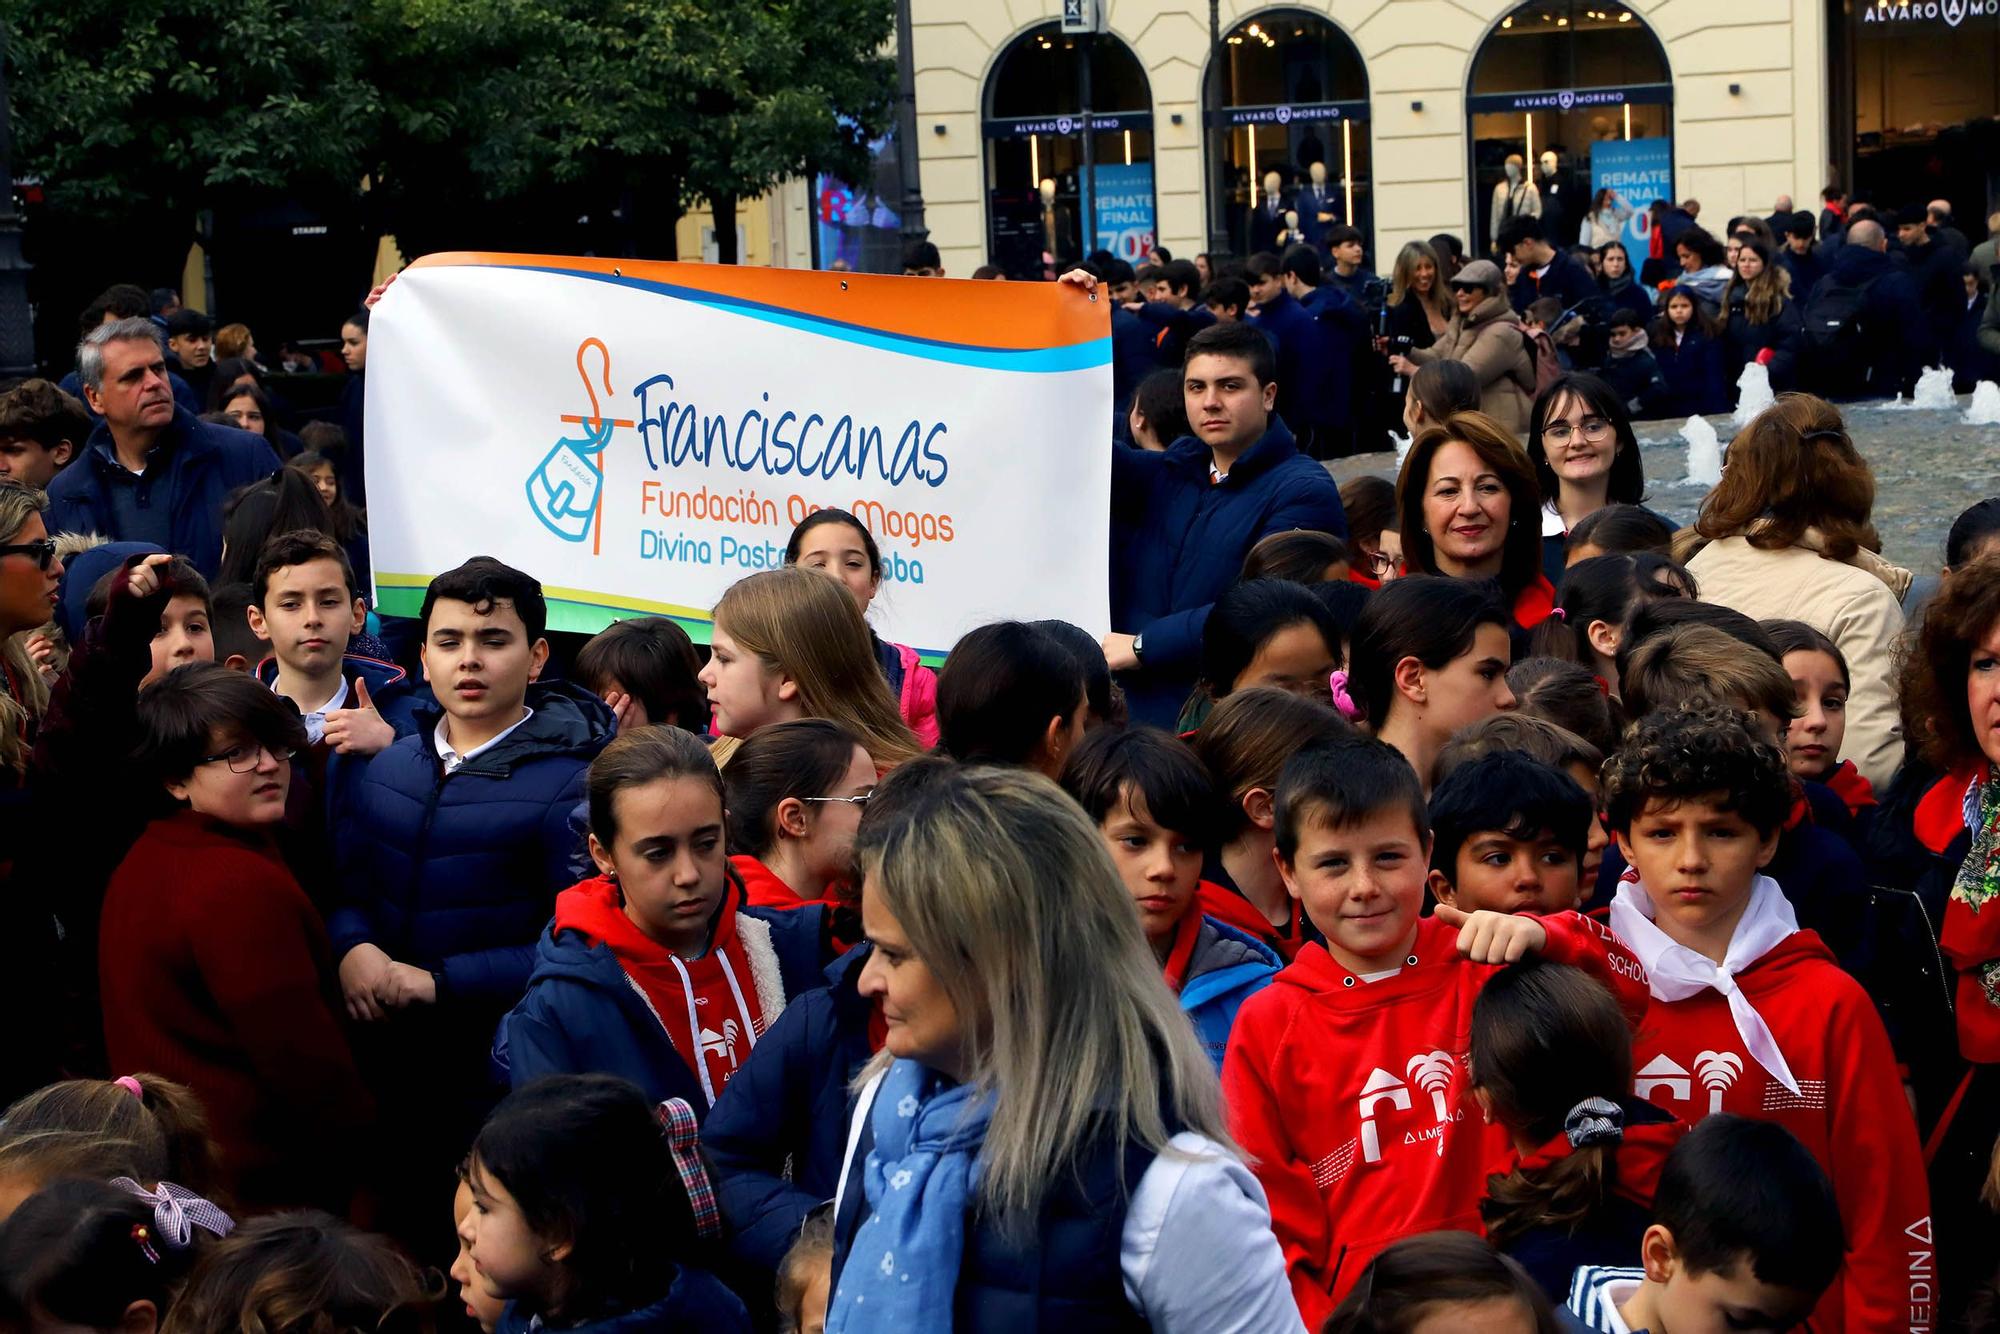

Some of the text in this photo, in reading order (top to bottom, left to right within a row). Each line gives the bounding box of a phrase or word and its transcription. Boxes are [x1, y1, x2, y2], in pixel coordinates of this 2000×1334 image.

[1864, 2, 1938, 22] ALVARO
[1970, 0, 1998, 16] MO
[1514, 96, 1558, 107] ALVARO
[1575, 92, 1624, 103] MORENO
[1233, 107, 1340, 122] ALVARO MORENO
[1014, 118, 1119, 132] ALVARO MENO
[1601, 169, 1670, 187] REMATE
[1102, 211, 1150, 224] FINAL
[633, 374, 949, 488] Franciscanas
[641, 480, 778, 527] Fundación
[852, 499, 955, 547] Mogas
[640, 529, 711, 564] Divina
[720, 536, 788, 569] Pasto
